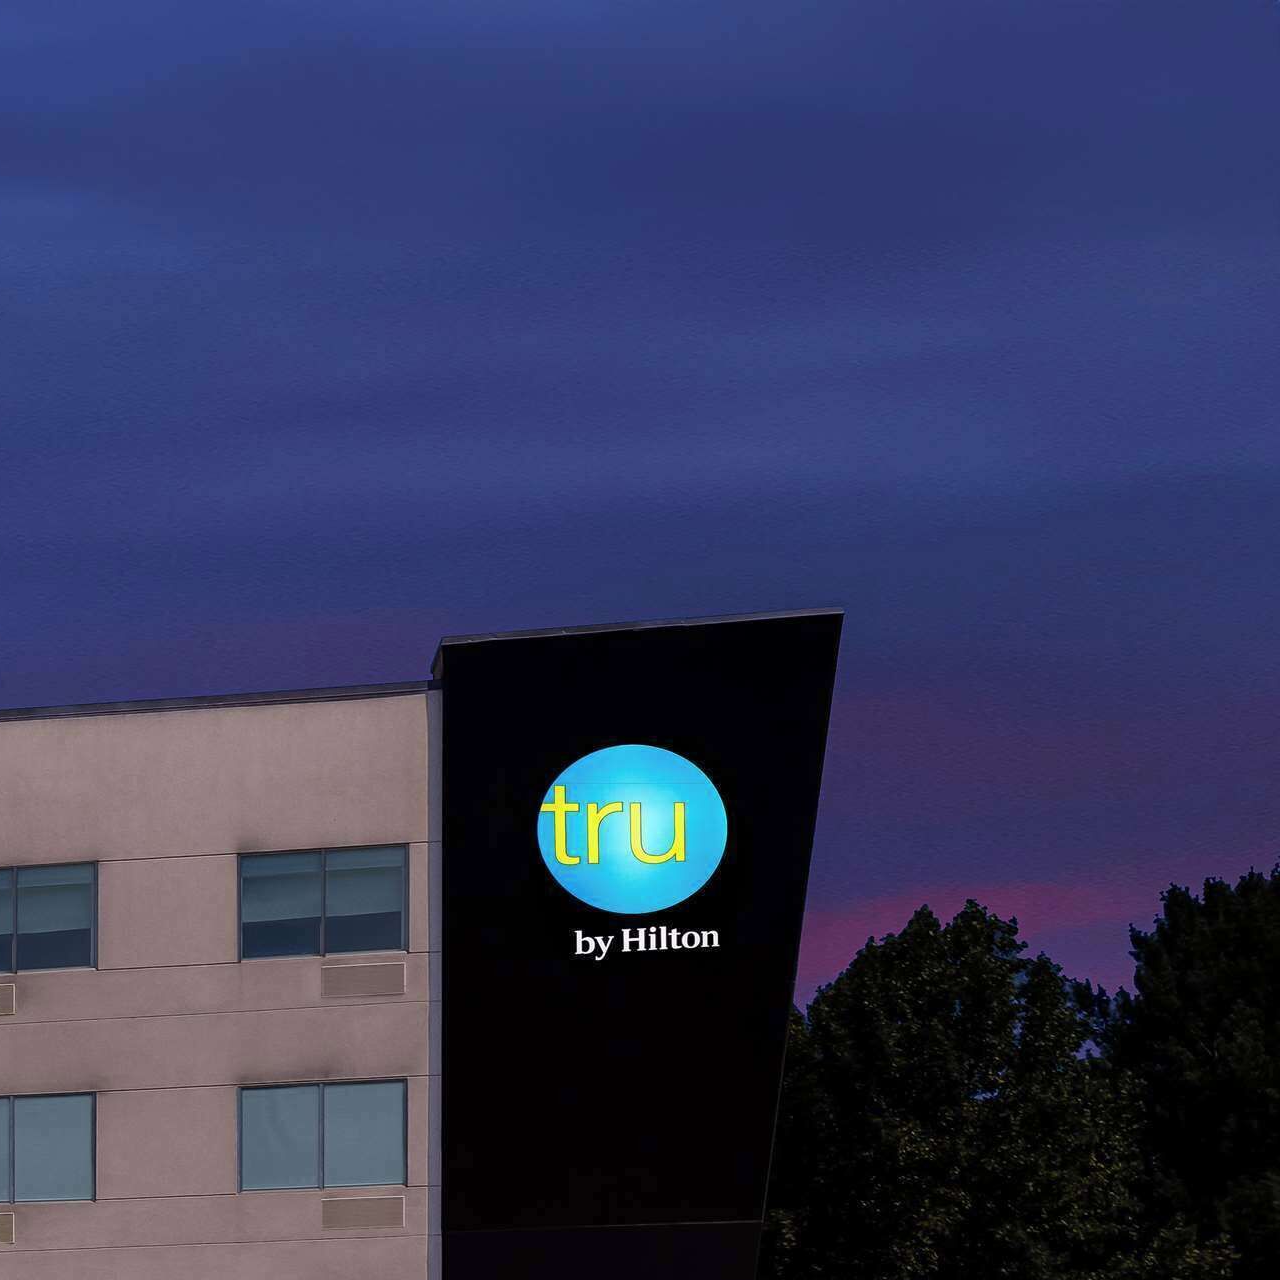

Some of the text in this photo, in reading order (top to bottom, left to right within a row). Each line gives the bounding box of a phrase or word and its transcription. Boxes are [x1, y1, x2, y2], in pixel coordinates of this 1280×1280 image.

[539, 784, 687, 865] tru
[574, 926, 720, 961] by Hilton
